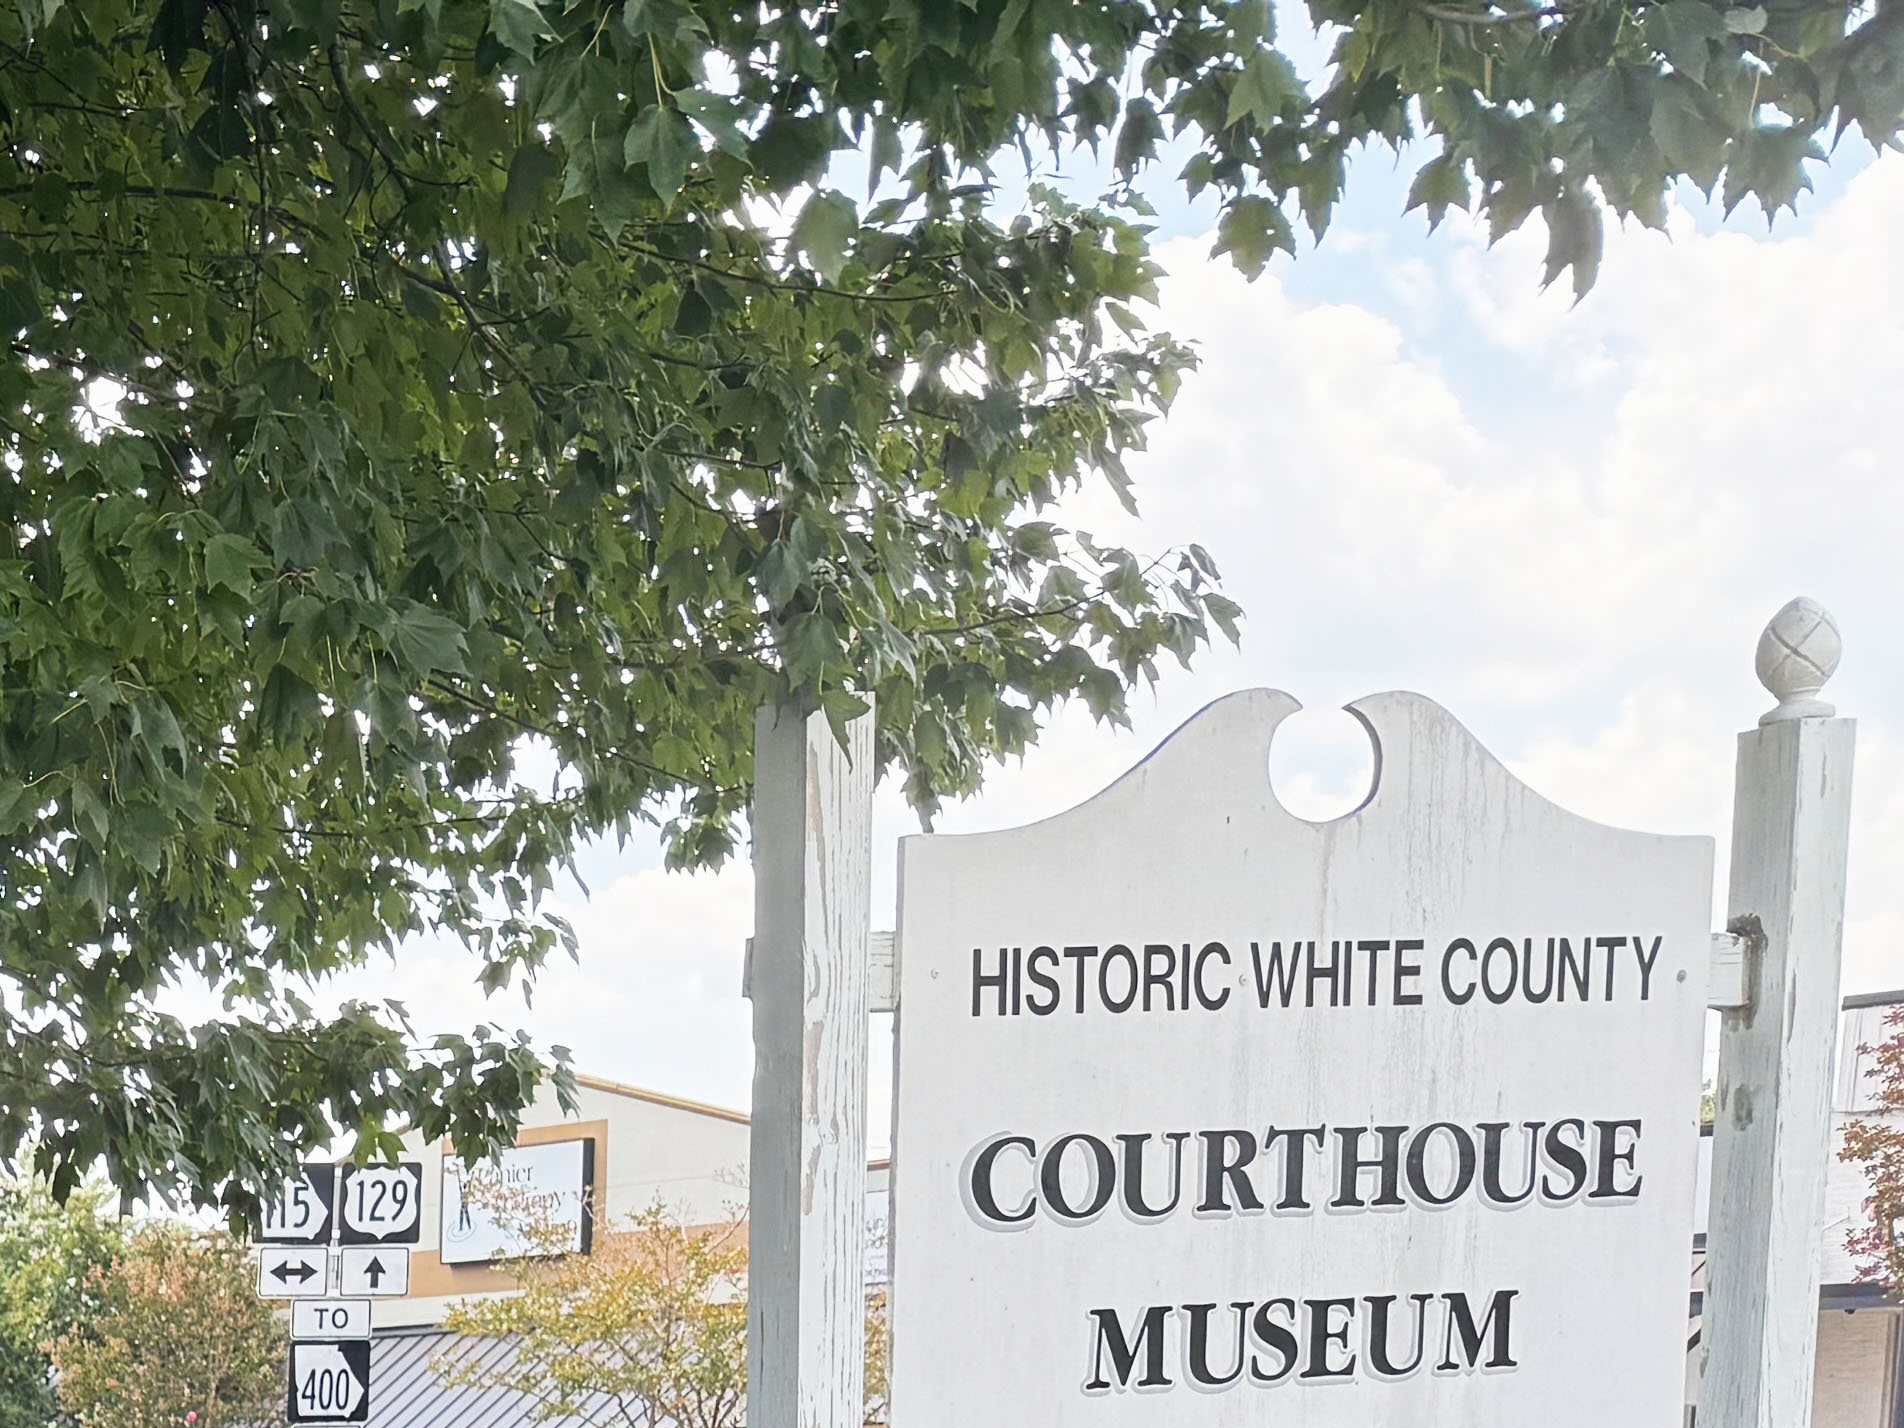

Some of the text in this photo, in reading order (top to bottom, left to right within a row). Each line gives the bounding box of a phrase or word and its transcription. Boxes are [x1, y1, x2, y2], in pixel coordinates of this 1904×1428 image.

[972, 936, 1662, 1017] HISTORIC WHITE COUNTY
[356, 1179, 409, 1223] 129
[970, 1118, 1643, 1222] COURTHOUSE
[313, 1308, 349, 1330] TO
[1085, 1290, 1519, 1390] MUSEUM
[301, 1367, 351, 1411] 400
